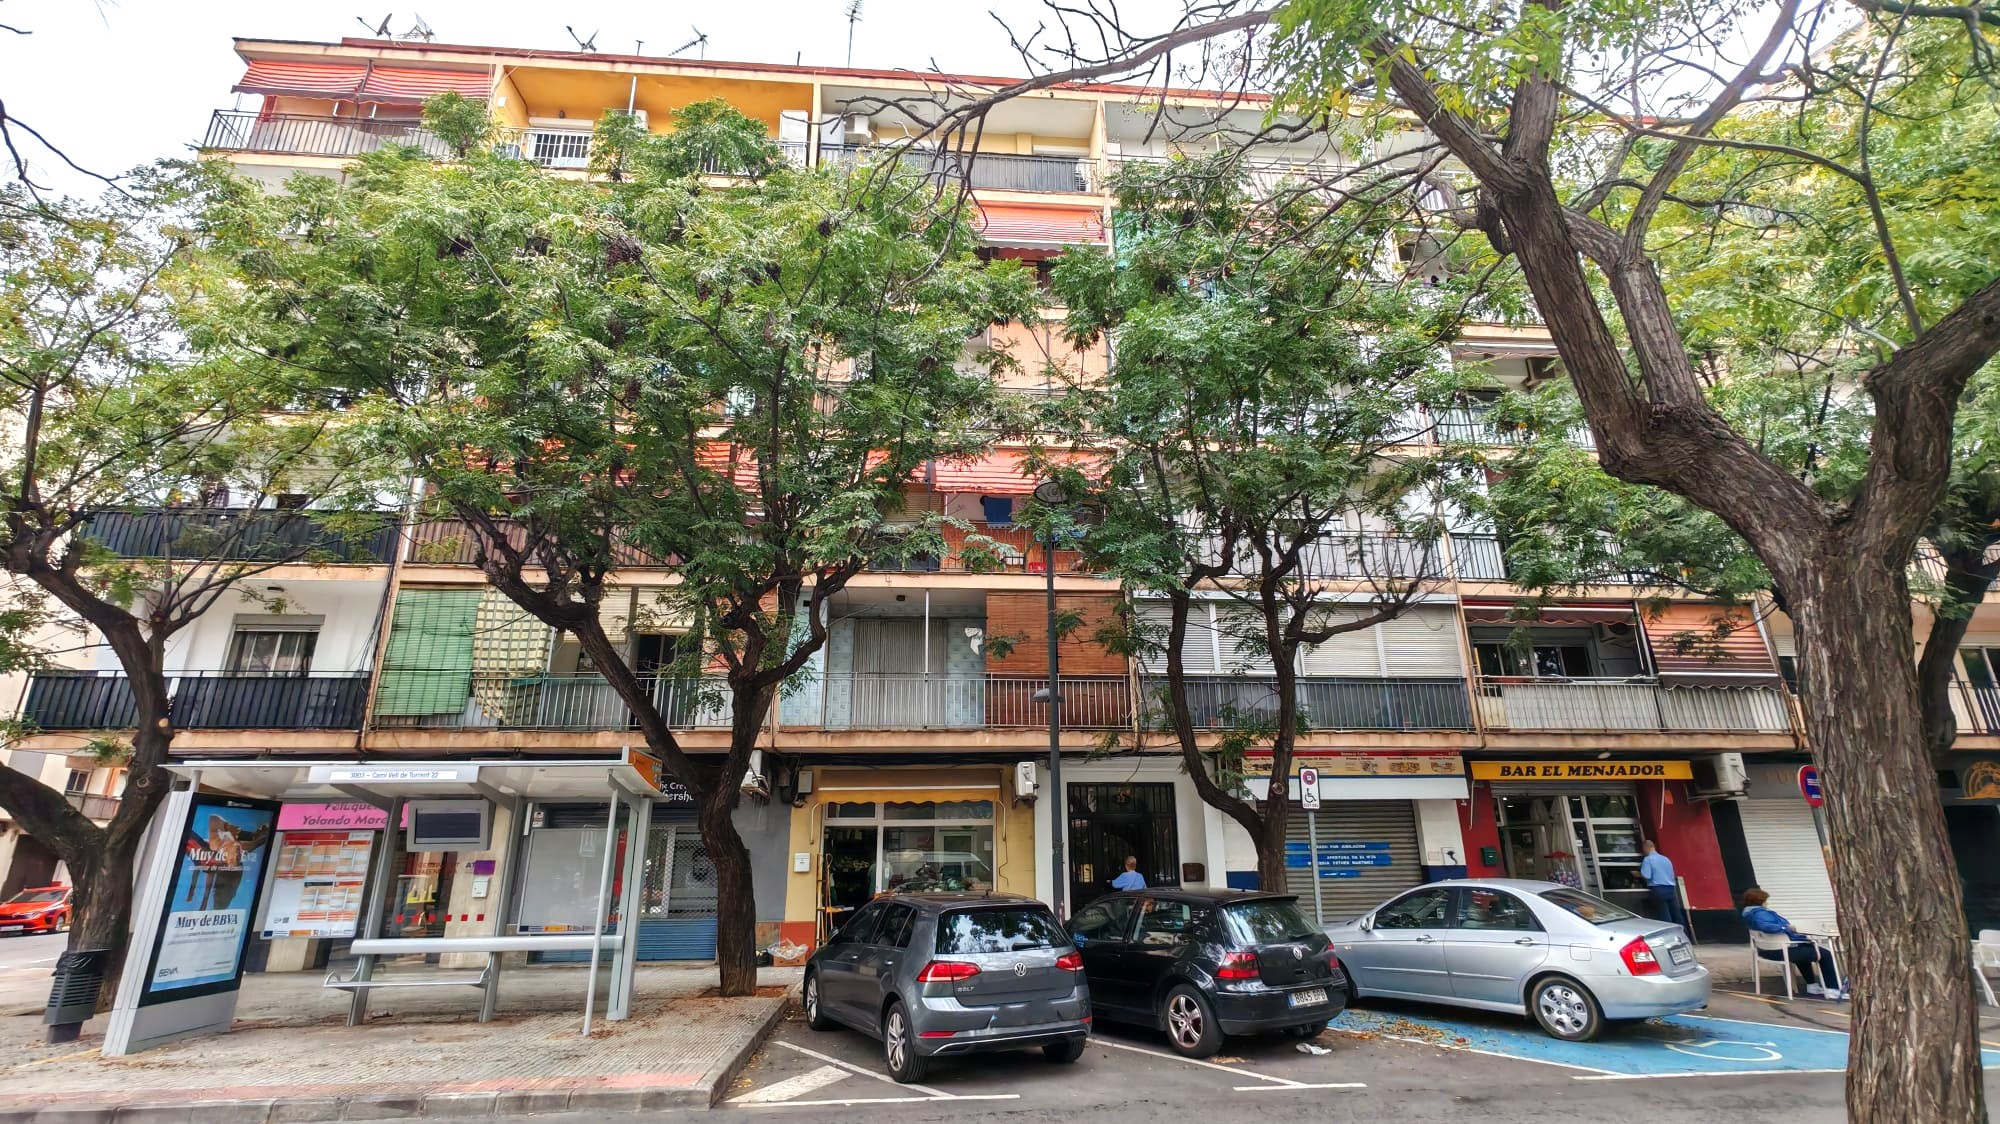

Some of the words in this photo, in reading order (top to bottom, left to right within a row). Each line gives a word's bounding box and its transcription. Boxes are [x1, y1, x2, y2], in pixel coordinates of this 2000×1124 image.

[1500, 765, 1537, 777] BAR
[1541, 765, 1563, 777] EL
[1567, 764, 1665, 777] MENJADOR
[669, 781, 687, 790] Cre
[190, 847, 215, 864] Muy
[175, 916, 197, 930] Muy
[200, 915, 212, 927] de
[212, 913, 238, 926] BBVA
